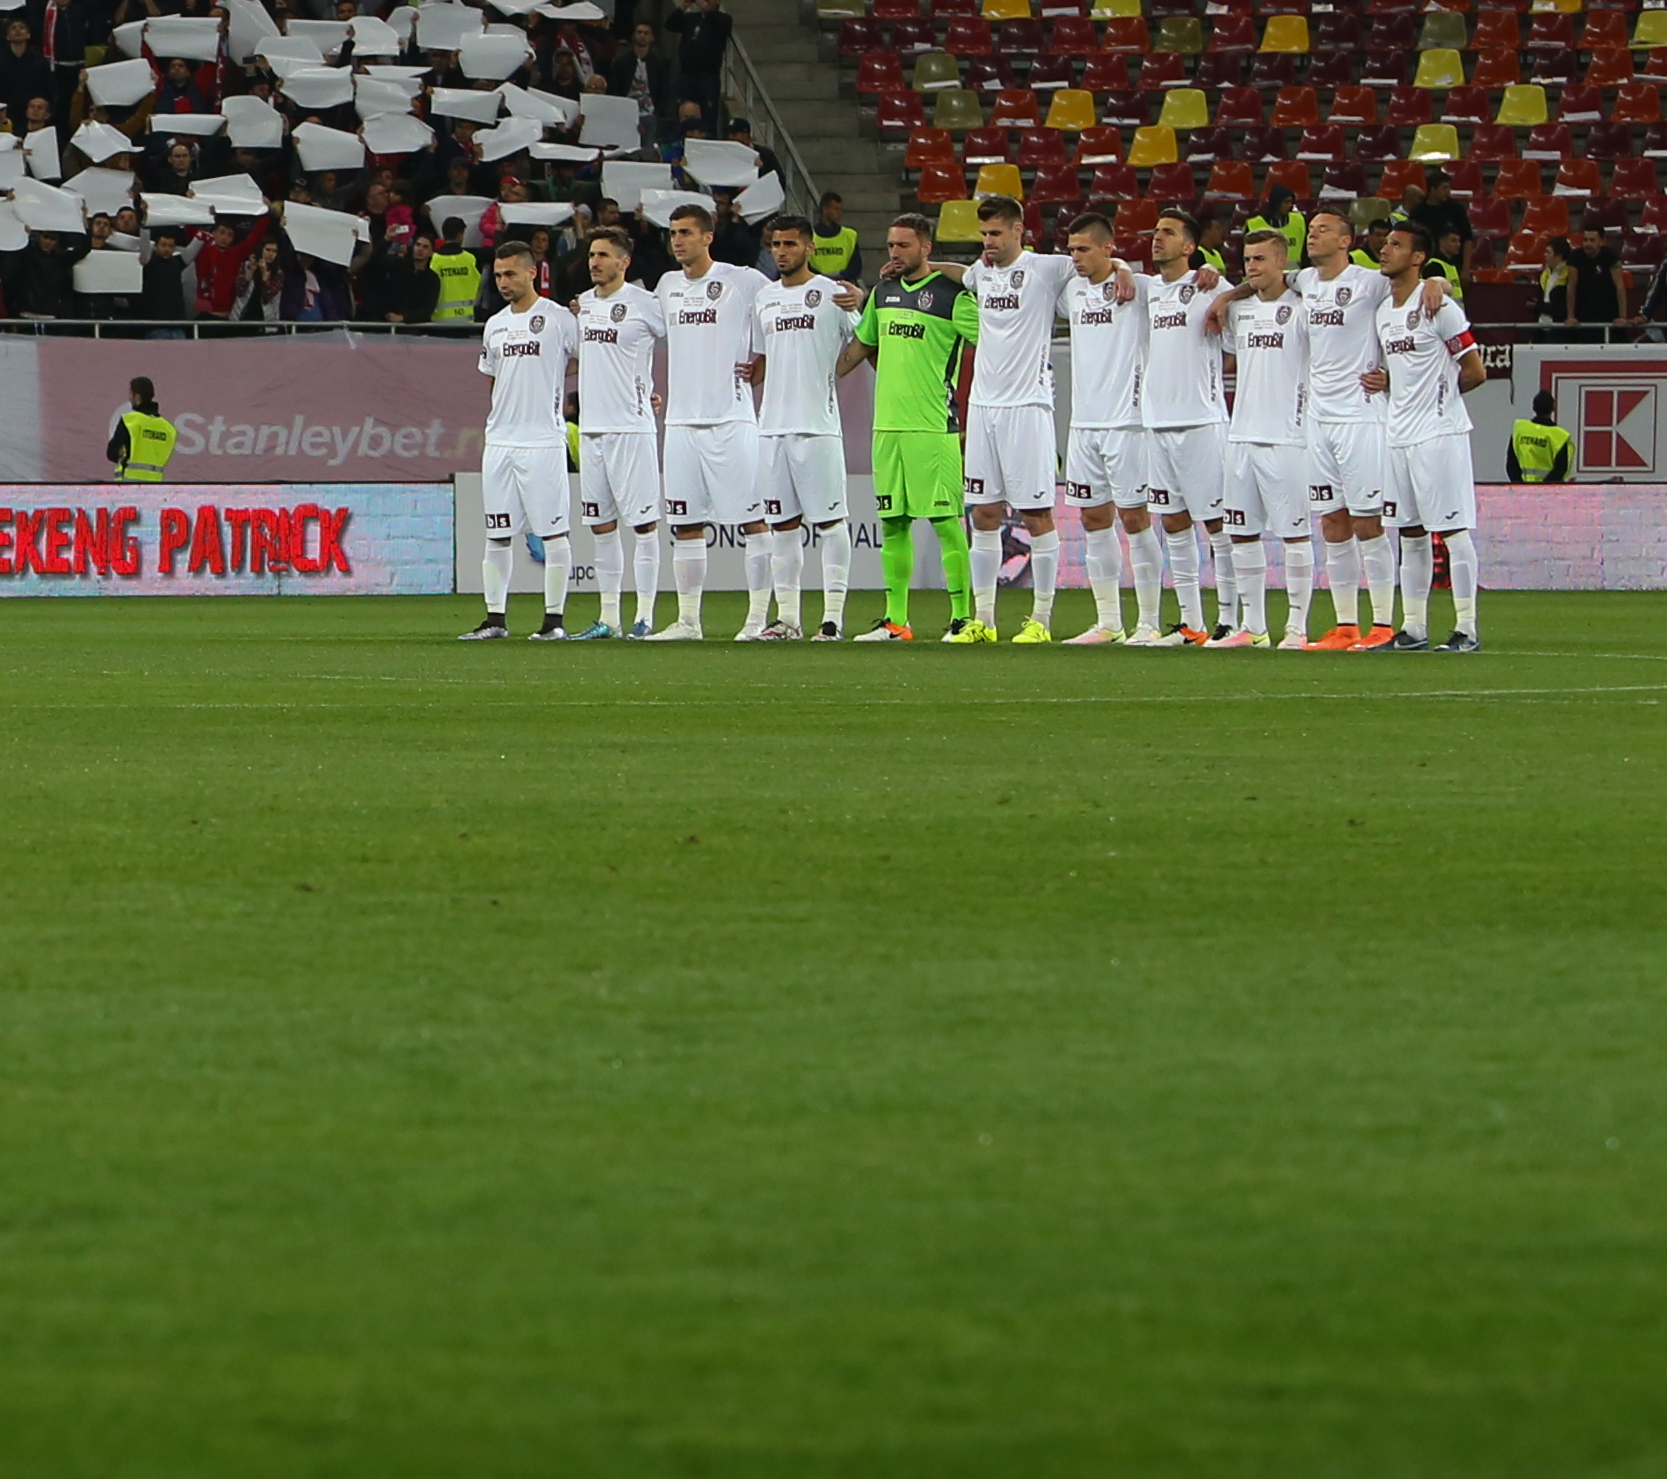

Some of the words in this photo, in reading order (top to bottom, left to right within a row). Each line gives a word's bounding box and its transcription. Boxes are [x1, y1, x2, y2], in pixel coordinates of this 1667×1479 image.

[439, 266, 469, 278] STEWARD
[678, 308, 718, 326] EnergoBit
[775, 314, 816, 333] EnergoBit
[1518, 435, 1548, 448] STEWARD
[157, 502, 350, 574] PATRICK
